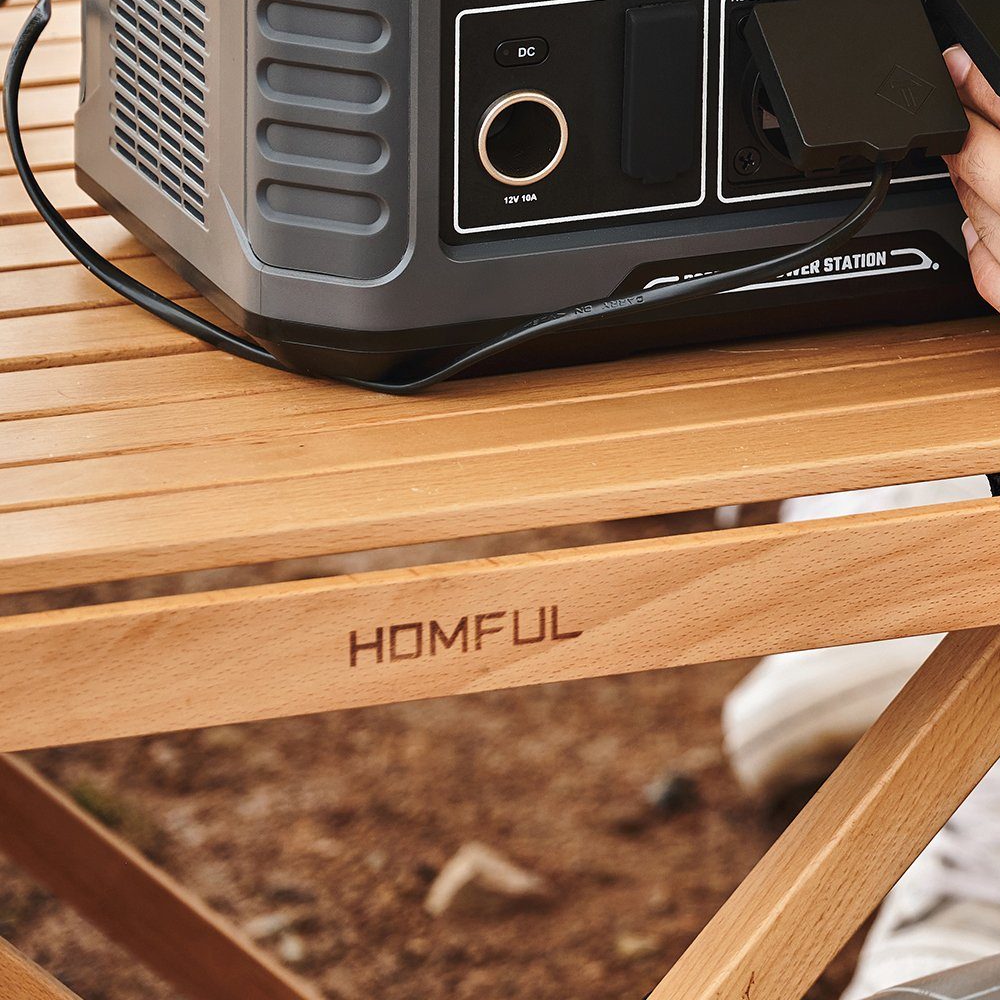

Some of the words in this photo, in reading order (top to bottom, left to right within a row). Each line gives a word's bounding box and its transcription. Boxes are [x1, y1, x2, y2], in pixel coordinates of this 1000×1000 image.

[518, 46, 536, 58] DC
[504, 194, 520, 205] 12V
[521, 193, 538, 203] 10A
[823, 251, 887, 273] STATION
[350, 604, 584, 668] HOMFUL
